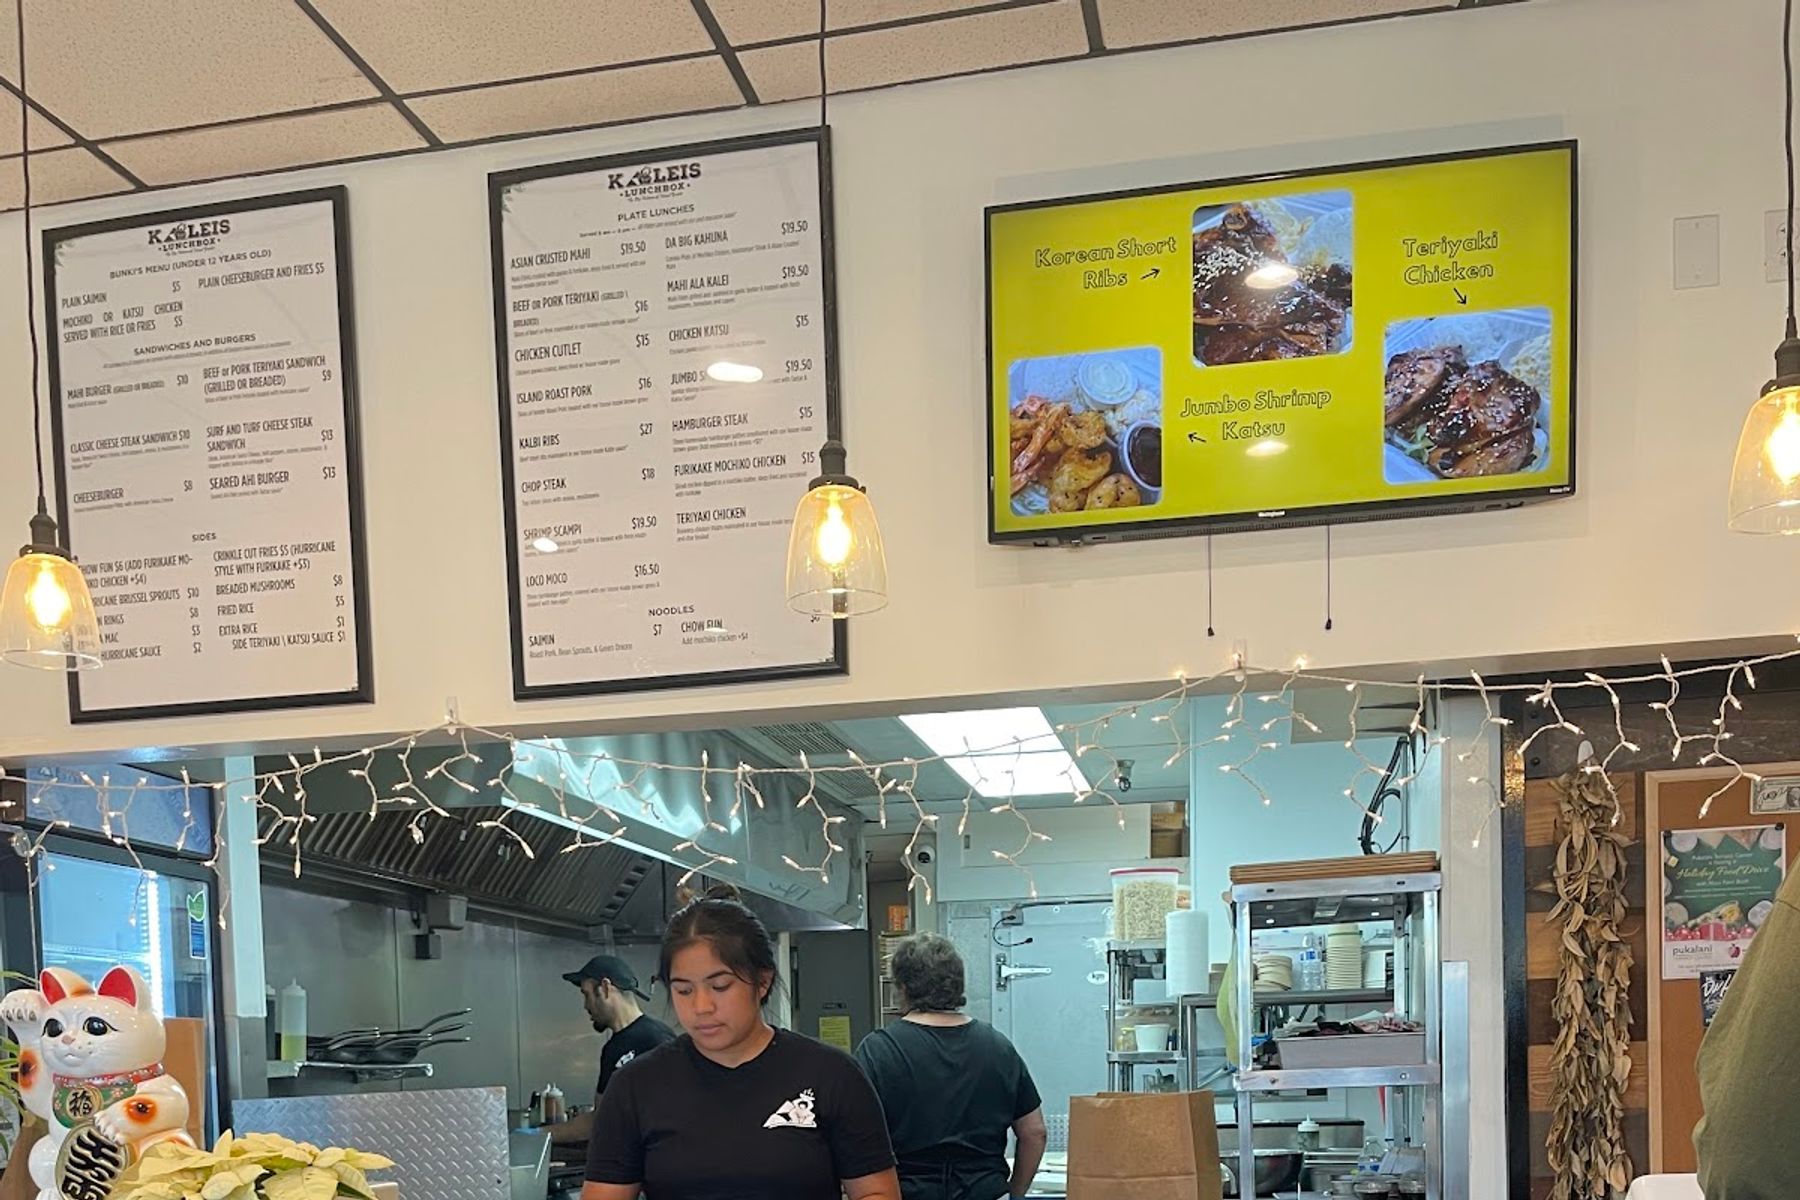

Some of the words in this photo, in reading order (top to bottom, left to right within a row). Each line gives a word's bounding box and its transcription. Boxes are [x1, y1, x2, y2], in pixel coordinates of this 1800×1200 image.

[624, 182, 685, 198] LUNCHBOX
[618, 210, 647, 222] PLATE
[650, 204, 694, 218] LUNCHES
[162, 238, 216, 252] LUNCHBOX
[665, 237, 677, 249] DA
[679, 235, 692, 247] BIG
[694, 231, 728, 246] KAHUNA
[781, 220, 808, 234] $19.50
[1402, 230, 1499, 260] Teriyaki
[146, 264, 170, 274] MENU
[172, 258, 206, 271] (UNDER
[208, 257, 216, 265] 12
[219, 252, 247, 263] YEARS
[249, 249, 272, 259] OLD)
[511, 257, 534, 269] ASIAN
[536, 252, 568, 266] CRUSTED
[570, 248, 590, 260] MAHI
[620, 241, 646, 255] $19.50
[1035, 246, 1115, 268] Korean
[1117, 234, 1176, 259] Short
[198, 278, 220, 289] PLAIN
[221, 268, 275, 286] CHEESEBURGER
[276, 267, 292, 278] AND
[294, 264, 314, 276] FRIES
[667, 279, 688, 292] MAHI
[689, 277, 704, 290] ALA
[707, 275, 728, 288] KALEI
[782, 264, 809, 279] $19.50
[1083, 268, 1128, 290] Ribs
[1404, 260, 1494, 286] Chicken
[62, 298, 81, 309] PLAIN
[513, 301, 530, 312] BEEF
[543, 295, 563, 308] PORK
[565, 292, 599, 304] TERIYAKI
[635, 300, 648, 313] $16
[669, 327, 701, 342] CHICKEN
[703, 324, 729, 338] KATSU
[796, 315, 809, 328] $15
[134, 341, 191, 356] SANDWICHES
[193, 338, 212, 348] AND
[214, 333, 256, 345] BURGERS
[515, 346, 550, 362] CHICKEN
[552, 342, 581, 357] CUTLET
[636, 334, 649, 348] $15
[203, 367, 220, 379] BEEF
[231, 363, 251, 376] PORK
[253, 360, 284, 374] TERIYAKI
[285, 355, 326, 369] SANDWICH
[671, 371, 696, 386] JUMBO
[785, 359, 812, 373] $19.50
[176, 374, 188, 386] $10
[204, 380, 235, 395] (GRILLED
[237, 379, 248, 390] OR
[249, 374, 286, 389] BREADED)
[516, 392, 543, 404] ISLAND
[545, 388, 569, 400] ROAST
[571, 384, 592, 397] PORK
[638, 377, 652, 390] $16
[1180, 396, 1251, 420] Jumbo
[1254, 388, 1331, 414] Shrimp
[206, 425, 224, 438] SURF
[226, 423, 241, 435] AND
[243, 421, 261, 433] TURF
[263, 418, 289, 431] CHEESE
[290, 417, 313, 429] STEAK
[672, 416, 722, 432] HAMBURGER
[724, 413, 748, 426] STEAK
[800, 407, 812, 419] $15
[96, 438, 119, 449] CHEESE
[120, 436, 140, 447] STEAK
[142, 431, 177, 445] SANDWICH
[207, 438, 246, 452] SANDWICH
[321, 429, 333, 441] $13
[519, 436, 540, 449] KALBI
[542, 434, 560, 446] RIBS
[640, 423, 653, 436] $27
[1222, 419, 1286, 442] Katsu
[674, 462, 712, 476] FURIKAKE
[715, 458, 751, 472] MOCHIKO
[753, 454, 786, 468] CHICKEN
[802, 451, 815, 464] $15
[210, 475, 239, 490] SEARED
[241, 474, 256, 486] AHI
[257, 471, 289, 485] BURGER
[322, 466, 336, 480] $13
[521, 480, 541, 493] CHOP
[543, 478, 566, 491] STEAK
[642, 468, 655, 480] $18
[74, 488, 124, 504] CHEESEBURGER
[676, 511, 711, 525] TERIYAKI
[713, 507, 746, 520] CHICKEN
[192, 533, 216, 542] SIDES
[523, 527, 552, 541] SHRIMP
[554, 523, 582, 537] SCAMPI
[632, 516, 657, 529] $19.50
[213, 549, 242, 561] CRINKLE
[244, 547, 256, 558] CUT
[259, 546, 278, 558] FRIES
[280, 544, 289, 557] $5
[290, 541, 336, 557] (HURRICANE
[100, 561, 114, 573] FUN
[124, 559, 142, 572] (ADD
[144, 555, 176, 569] FURIKAKE
[214, 565, 234, 576] STYLE
[236, 564, 254, 574] WITH
[256, 560, 291, 573] FURIKAKE
[100, 574, 129, 588] CHICKEN
[216, 583, 248, 595] BREADED
[250, 579, 295, 592] MUSHROOMS
[333, 575, 343, 586] $8
[526, 575, 544, 587] LOCO
[546, 572, 568, 585] MOCO
[634, 563, 660, 577] $16.50
[119, 592, 148, 605] BRUSSEL
[150, 589, 180, 602] SPROUTS
[187, 587, 199, 599] $10
[217, 605, 237, 616] FRIED
[239, 603, 254, 613] RICE
[336, 596, 345, 607] $5
[104, 614, 124, 625] RINGS
[649, 605, 695, 616] NOODLES
[105, 632, 119, 643] MAC
[219, 625, 241, 636] EXTRA
[242, 623, 258, 634] RICE
[529, 634, 555, 647] SAIMIN
[653, 624, 662, 636] $7
[681, 621, 705, 633] CHOW
[232, 638, 247, 650] SIDE
[249, 635, 280, 649] TERIYAKI
[287, 634, 310, 644] KATSU
[312, 632, 333, 643] SAUCE
[101, 647, 138, 661] HURRICANE
[140, 646, 161, 657] SAUCE
[1672, 946, 1712, 956] pukalani
